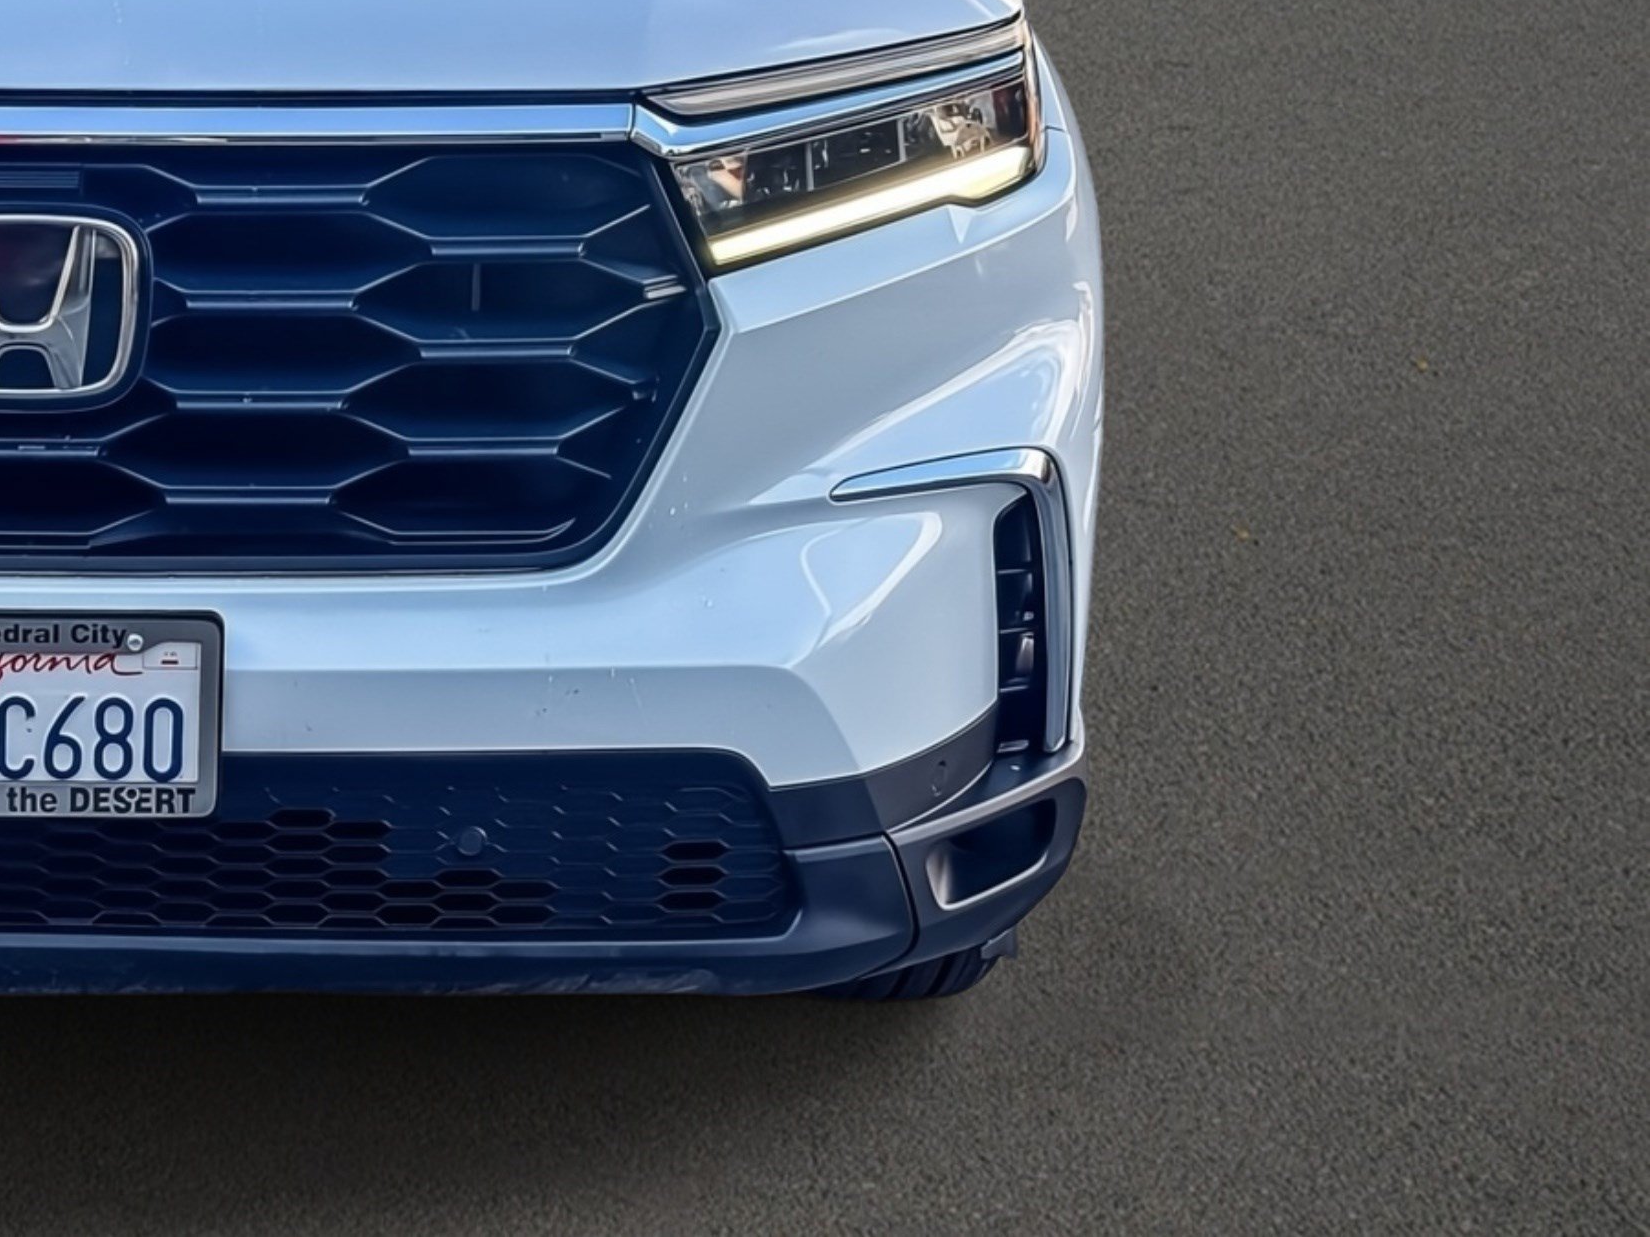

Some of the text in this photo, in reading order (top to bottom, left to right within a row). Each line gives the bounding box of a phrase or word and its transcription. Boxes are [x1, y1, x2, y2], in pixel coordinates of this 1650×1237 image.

[70, 622, 127, 648] City
[8, 786, 57, 812] the
[69, 786, 196, 814] DESERT
